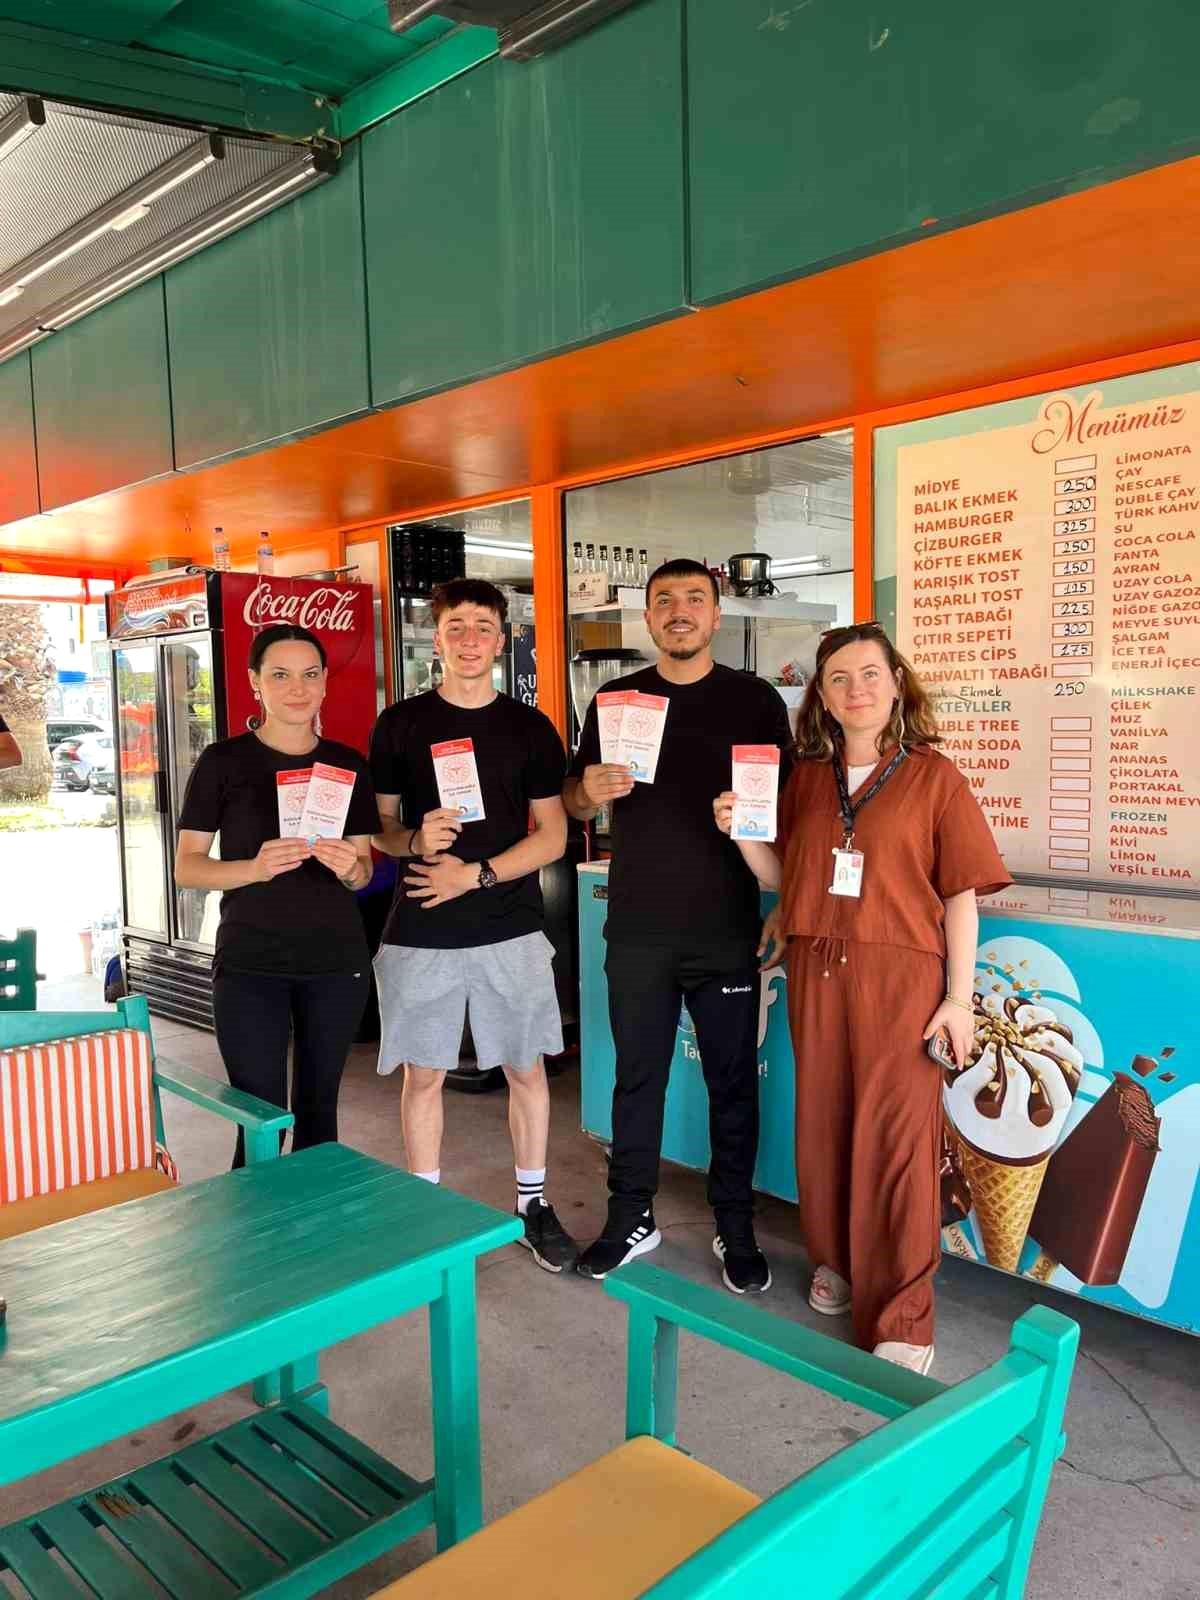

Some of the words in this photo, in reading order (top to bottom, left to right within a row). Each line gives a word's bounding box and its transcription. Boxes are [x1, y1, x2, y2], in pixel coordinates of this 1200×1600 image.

[1032, 398, 1186, 454] Menümüz
[1115, 445, 1192, 465] LİMONATA
[1115, 467, 1142, 480] ÇAY
[914, 478, 960, 496] MİDYE
[1063, 476, 1096, 492] 250
[1115, 475, 1181, 492] NESCAFE
[914, 498, 958, 515] BALIK
[962, 489, 1018, 508] EKMEK
[1115, 491, 1164, 506] DUBLE
[1167, 487, 1196, 501] ÇAY
[1064, 497, 1091, 514] 300
[1114, 507, 1154, 520] TÜRK
[1158, 501, 1200, 514] KAHV
[914, 510, 1014, 534] HAMBURGER
[1114, 523, 1133, 534] SU
[913, 531, 1003, 556] ÇİZBURGER
[1113, 535, 1152, 548] COCA
[1156, 530, 1196, 543] COLA
[914, 556, 962, 571] KÖFTE
[967, 548, 1023, 566] EKMEK
[1113, 548, 1160, 561] FANTA
[1112, 562, 1160, 575] AYRAN
[914, 574, 975, 591] KARIŞIK
[979, 568, 1020, 584] TOST
[1113, 577, 1150, 588] UZAY
[1153, 574, 1193, 585] COLA
[913, 592, 977, 610] KAŞARLI
[981, 588, 1024, 602] TOST
[1113, 590, 1150, 602] UZAY
[1112, 604, 1158, 616] NİĞDE
[1161, 601, 1200, 613] GAZO
[913, 613, 952, 627] TOST
[955, 606, 1012, 624] TABAĞI
[1112, 618, 1160, 630] MEYVE
[913, 632, 952, 649] ÇITIR
[956, 626, 1012, 643] SEPETİ
[1112, 631, 1170, 645] ŞALGAM
[913, 650, 976, 665] PATATES
[980, 646, 1017, 661] CİPS
[1138, 646, 1166, 656] TEA
[1111, 657, 1163, 671] ENERJİ
[1167, 656, 1200, 669] İÇEC
[989, 664, 1047, 680] TABAĞI
[1053, 681, 1086, 697] 250
[1111, 686, 1197, 697] MİLKSHAKE
[935, 701, 1012, 713] KTEYLLER
[1110, 699, 1152, 712] ÇİLEK
[935, 720, 975, 732] UBLE
[979, 720, 1020, 732] TREE
[1110, 714, 1142, 724] MUZ
[1110, 727, 1168, 737] VANİLYA
[977, 739, 1022, 751] SODA
[1110, 741, 1139, 750] NAR
[1109, 755, 1168, 765] ANANAS
[1109, 767, 1179, 779] ÇİKOLATA
[1109, 781, 1185, 792] PORTAKAL
[977, 796, 1023, 809] AHVE
[1109, 795, 1161, 805] ORMAN
[1166, 797, 1200, 807] MEY
[990, 813, 1029, 829] TİME
[1110, 811, 1168, 822] FROZEN
[1109, 825, 1168, 836] ANANAS
[1110, 836, 1137, 848] KİVİ
[1110, 849, 1156, 862] LİMON
[1108, 864, 1148, 877] YEŞİL
[1151, 867, 1192, 879] ELMA
